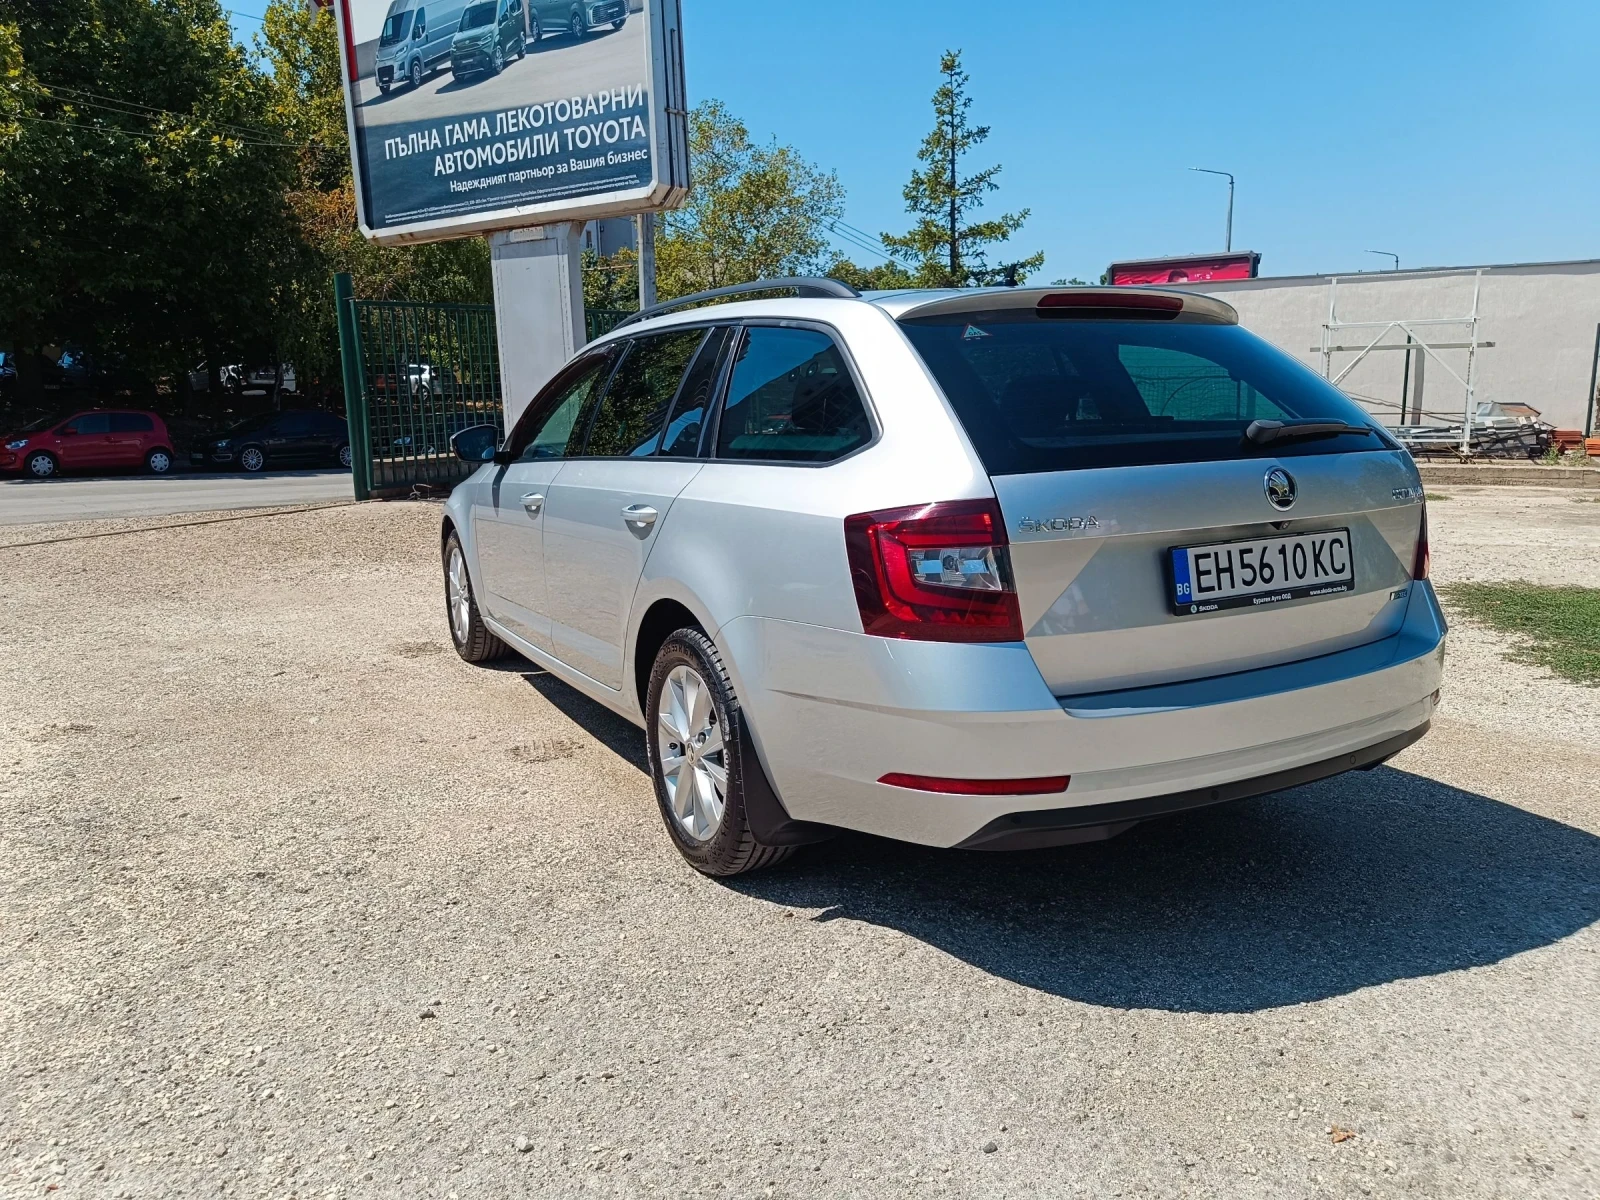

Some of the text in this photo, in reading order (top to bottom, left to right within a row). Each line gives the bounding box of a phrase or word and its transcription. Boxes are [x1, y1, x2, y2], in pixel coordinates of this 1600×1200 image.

[385, 83, 643, 160] ПЪЛНА ГАМА ЛЕКОТОВАРНИ
[434, 115, 647, 177] АВТОМОБИЛИ TOYOTA
[450, 149, 648, 193] Надеждният партньор за Вашия бизнес
[1018, 515, 1100, 534] ŠKODA
[1176, 583, 1190, 596] BG
